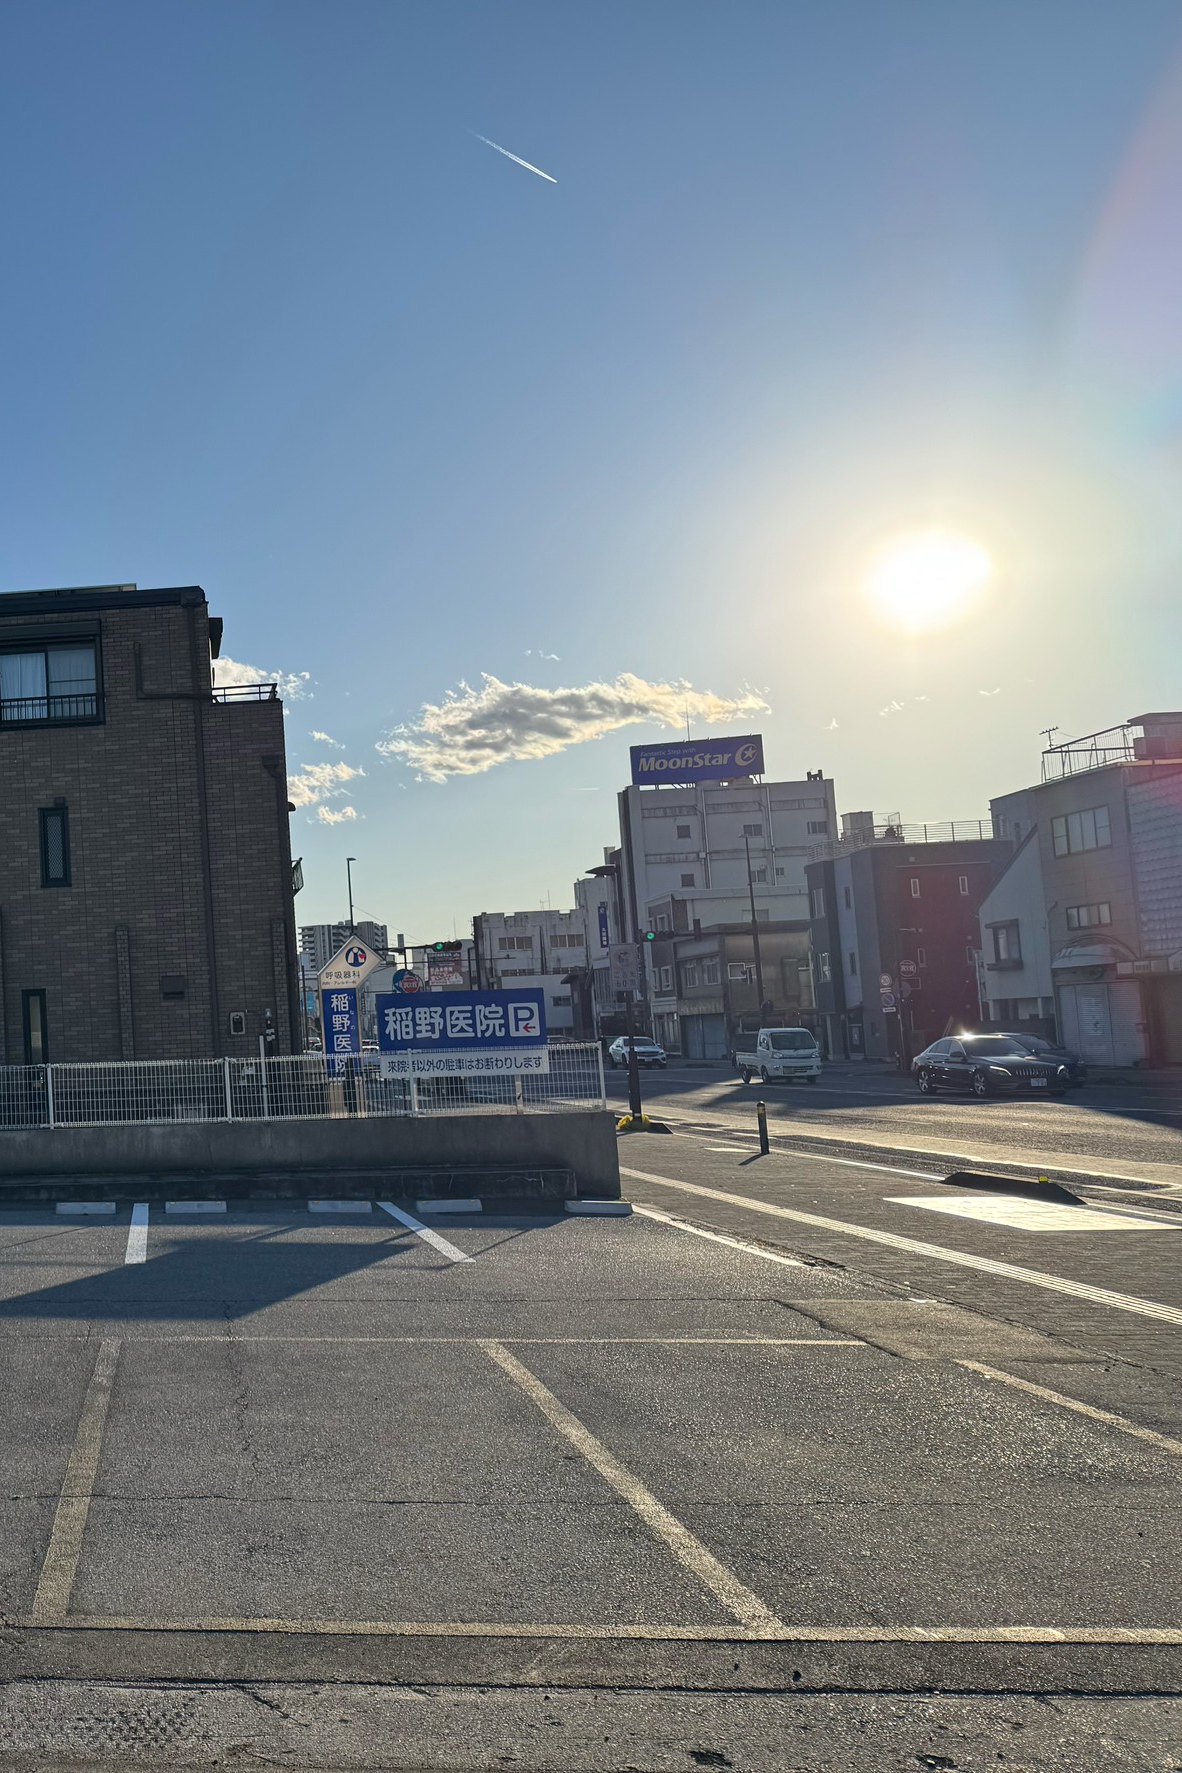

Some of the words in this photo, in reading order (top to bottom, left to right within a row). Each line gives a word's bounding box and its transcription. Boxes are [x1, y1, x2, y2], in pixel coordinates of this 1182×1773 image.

[640, 749, 667, 757] Fantastic
[667, 748, 681, 756] Step
[638, 753, 732, 772] MoonStar
[325, 970, 360, 980] 呼吸器科
[384, 1003, 506, 1041] 稲野医院
